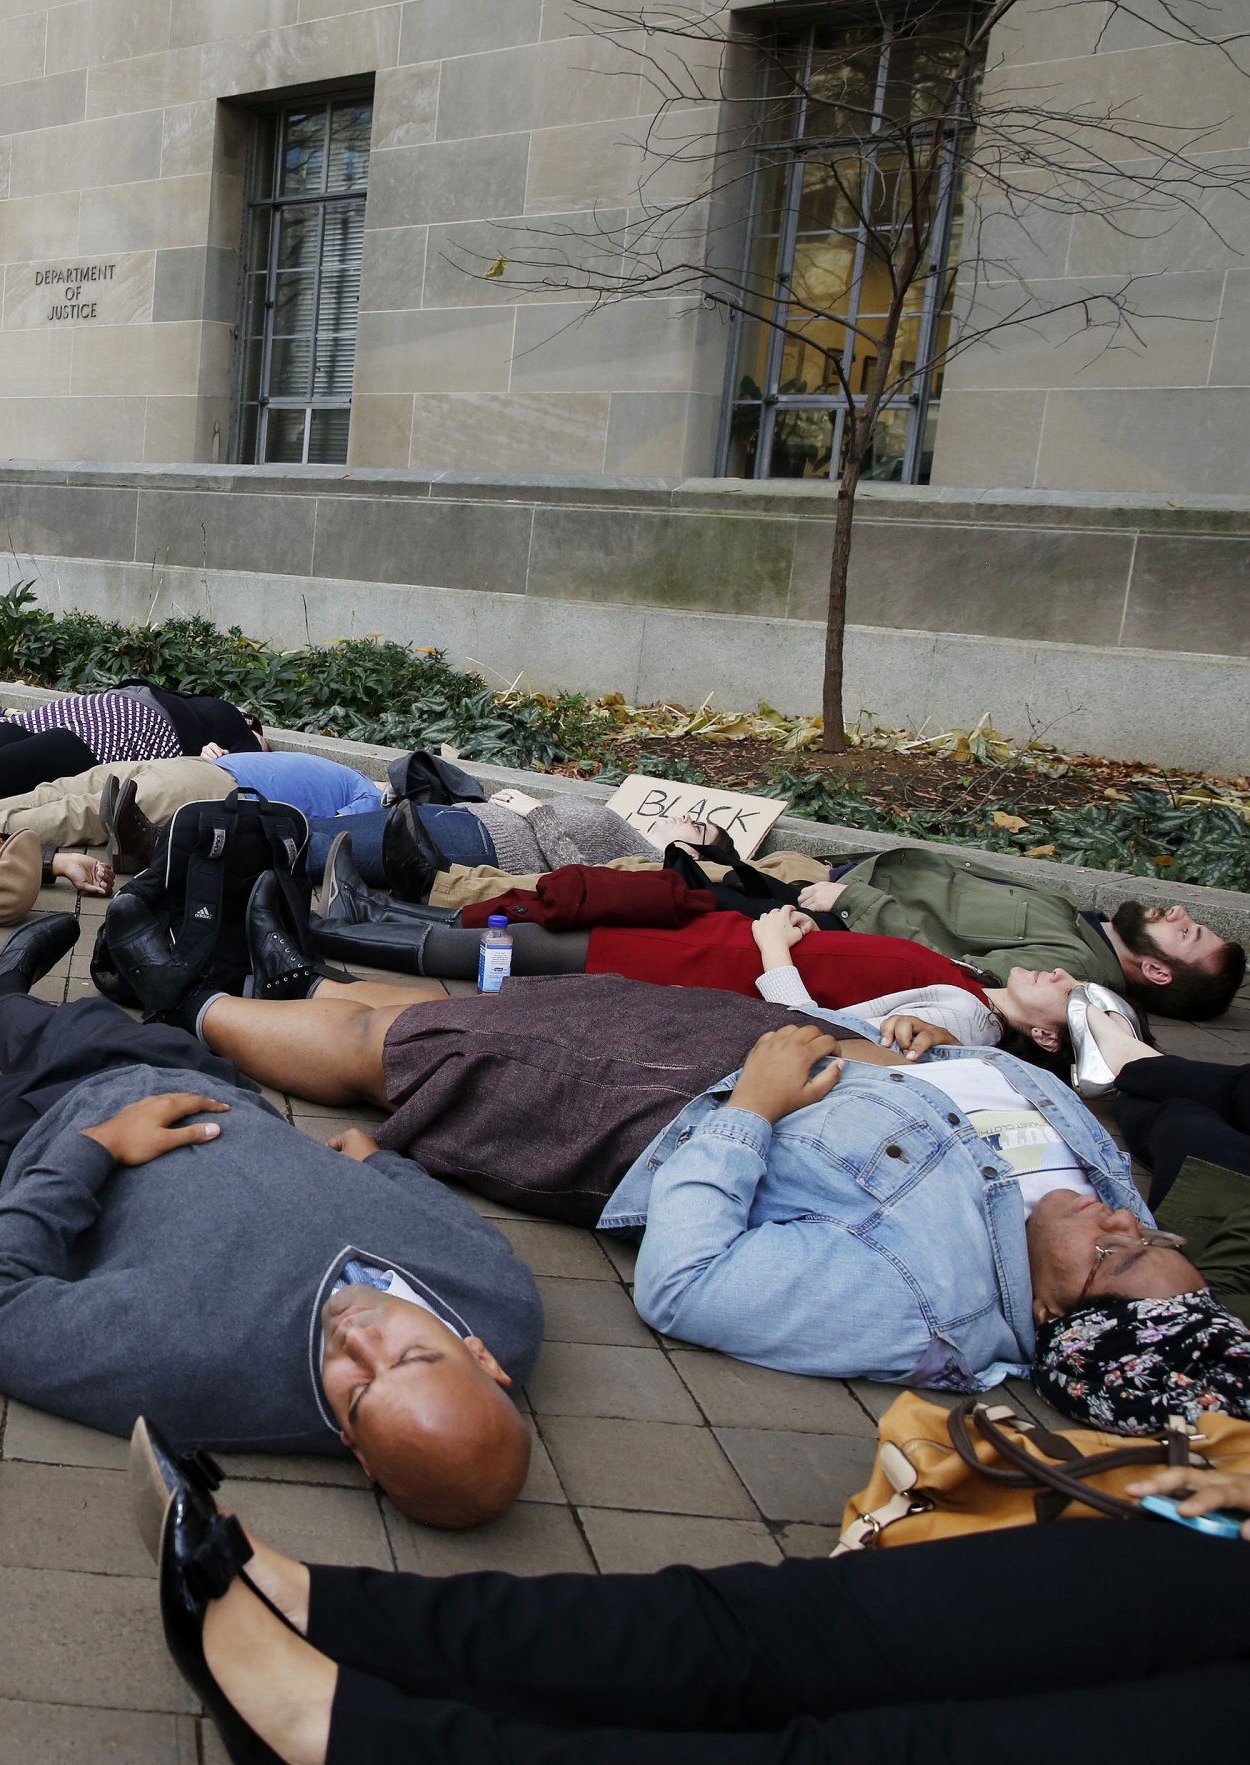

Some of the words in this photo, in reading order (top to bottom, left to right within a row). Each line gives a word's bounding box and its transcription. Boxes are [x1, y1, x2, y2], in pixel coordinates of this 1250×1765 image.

[35, 264, 116, 285] DEPARTMENT
[65, 286, 81, 301] OF
[47, 303, 97, 320] JUSTICE
[637, 789, 760, 833] BLACK
